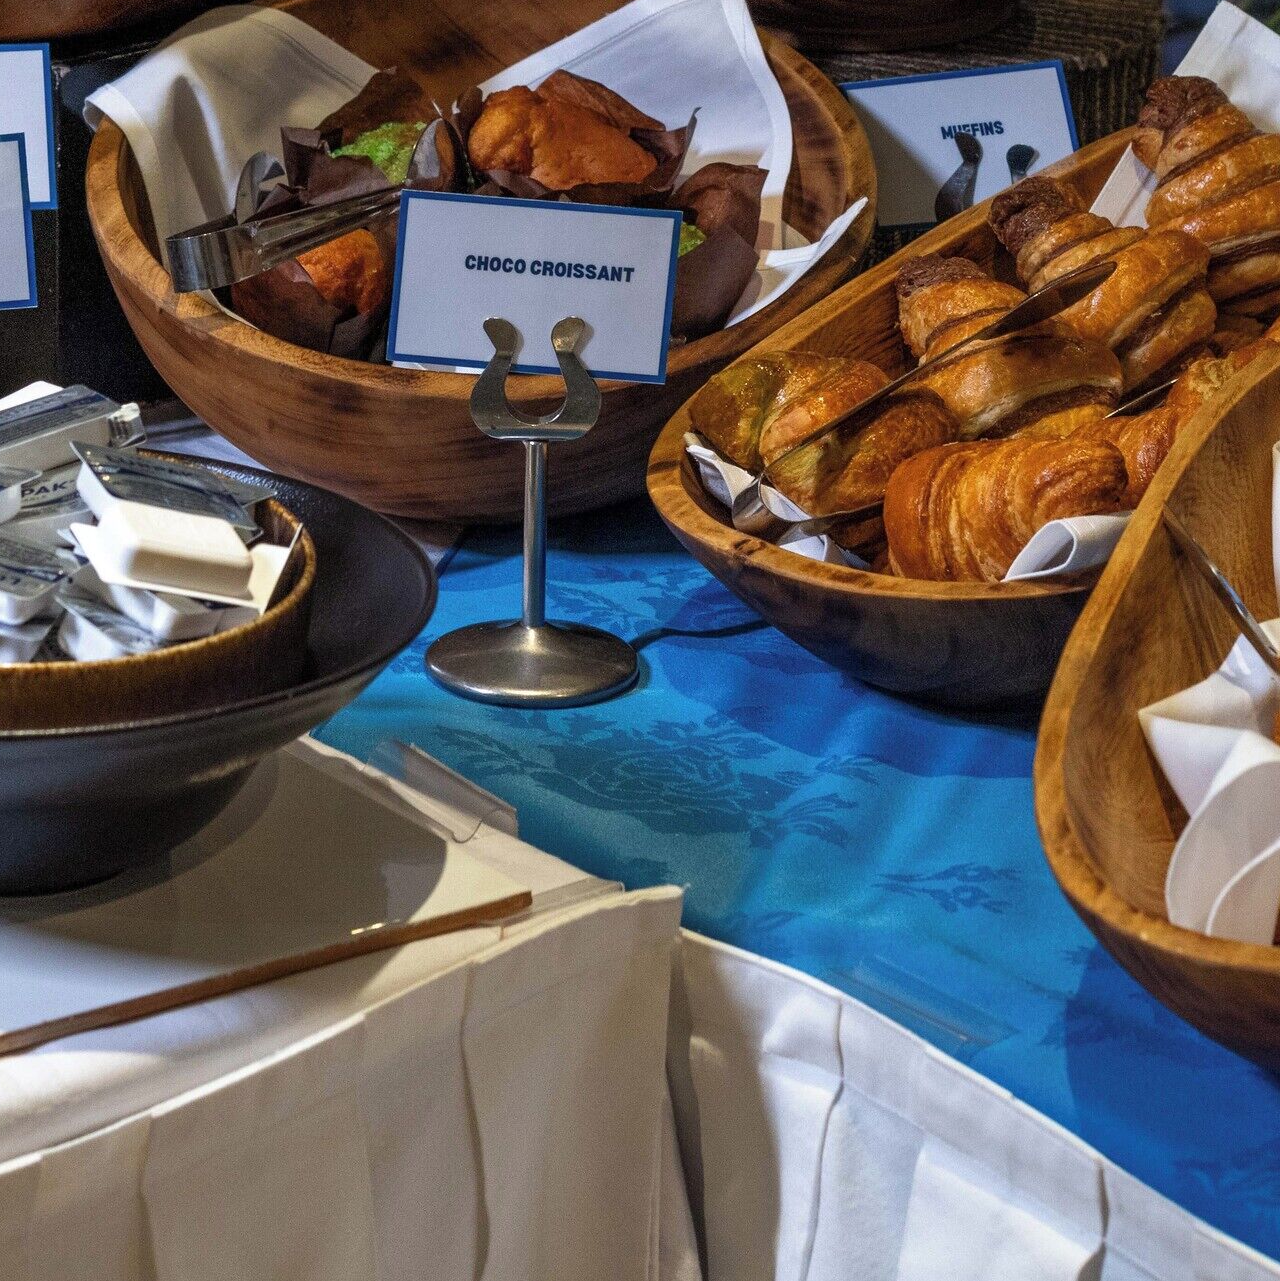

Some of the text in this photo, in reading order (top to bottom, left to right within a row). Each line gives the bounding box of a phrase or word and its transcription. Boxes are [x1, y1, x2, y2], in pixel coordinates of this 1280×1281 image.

[940, 121, 1005, 140] MUFFINS
[464, 254, 635, 282] CHOCO CROISSANT
